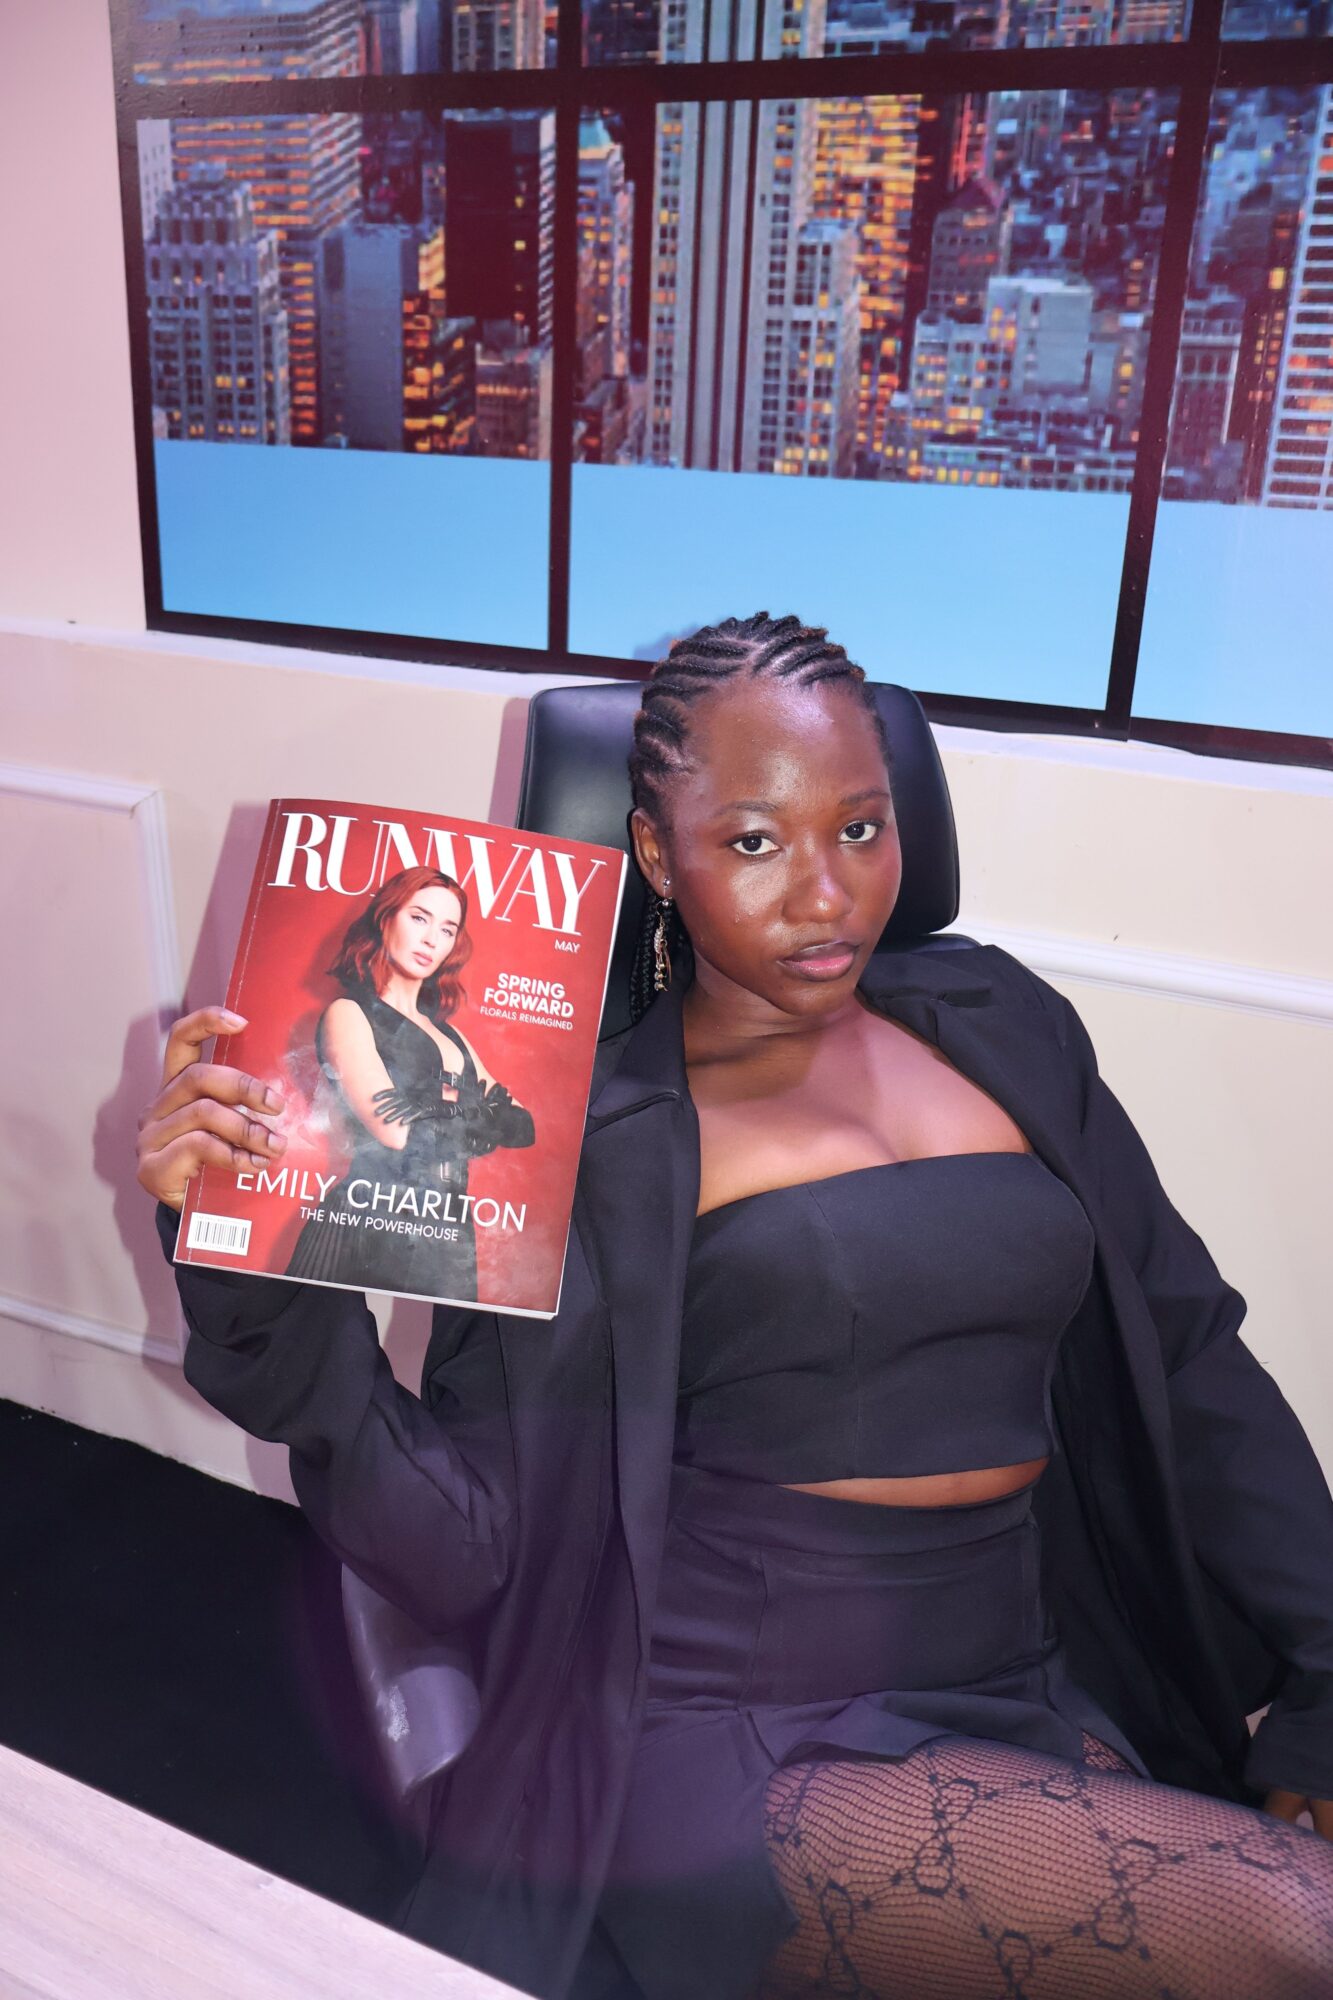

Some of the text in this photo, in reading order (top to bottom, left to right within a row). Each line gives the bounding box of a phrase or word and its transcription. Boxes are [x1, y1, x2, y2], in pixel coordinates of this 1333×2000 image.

[267, 812, 607, 935] RUNWAY
[554, 939, 580, 953] MAY
[497, 972, 566, 999] SPRING
[483, 987, 574, 1018] FORWARD
[480, 1006, 573, 1031] FLORALS REIMAGINED
[236, 1167, 527, 1232] EMILY CHARLTON
[300, 1206, 459, 1242] THE NEW POWERHOUSE
